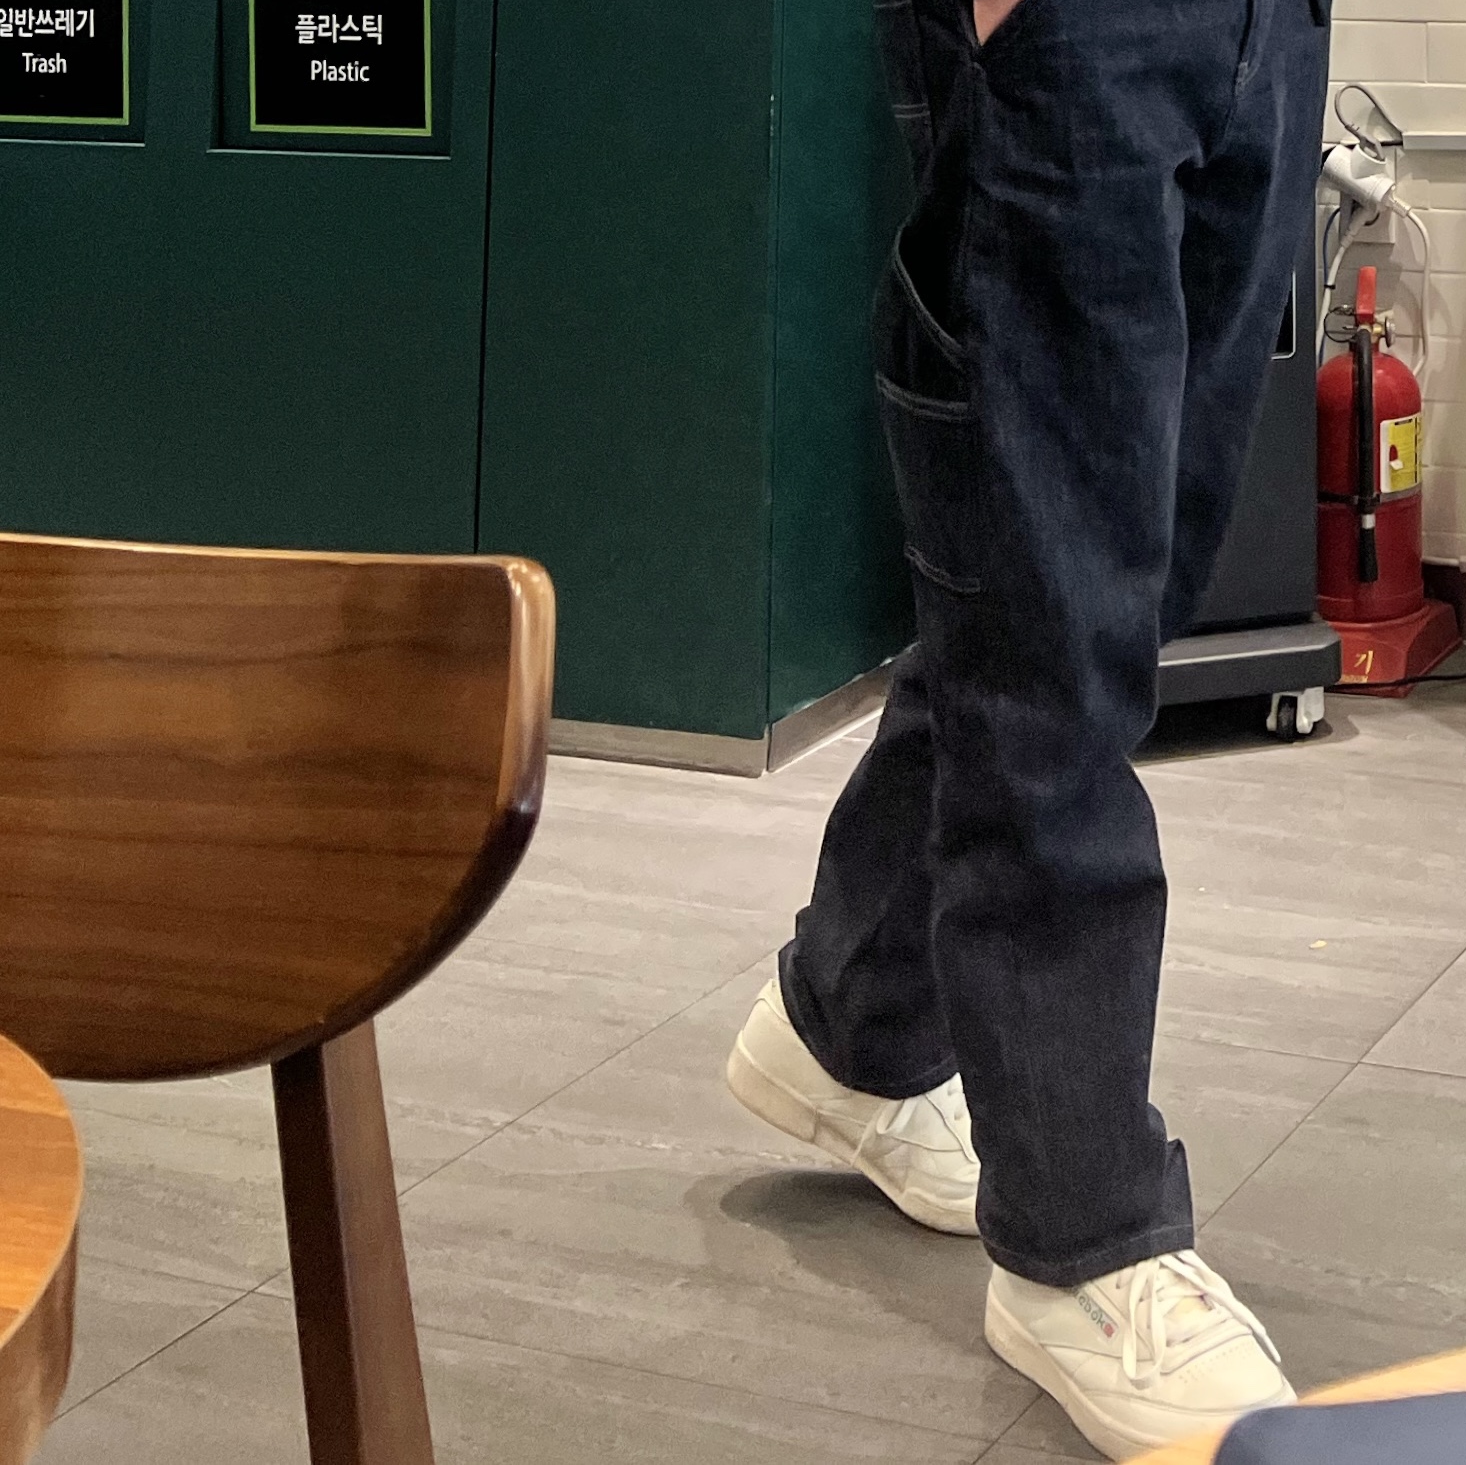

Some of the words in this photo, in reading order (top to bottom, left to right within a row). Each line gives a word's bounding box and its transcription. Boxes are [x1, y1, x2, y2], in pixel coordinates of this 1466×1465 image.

[0, 7, 95, 38] 일반쓰레기
[294, 13, 383, 45] 플라스틱
[22, 52, 67, 74] Trash
[310, 59, 370, 82] Plastic
[1354, 650, 1374, 675] 기
